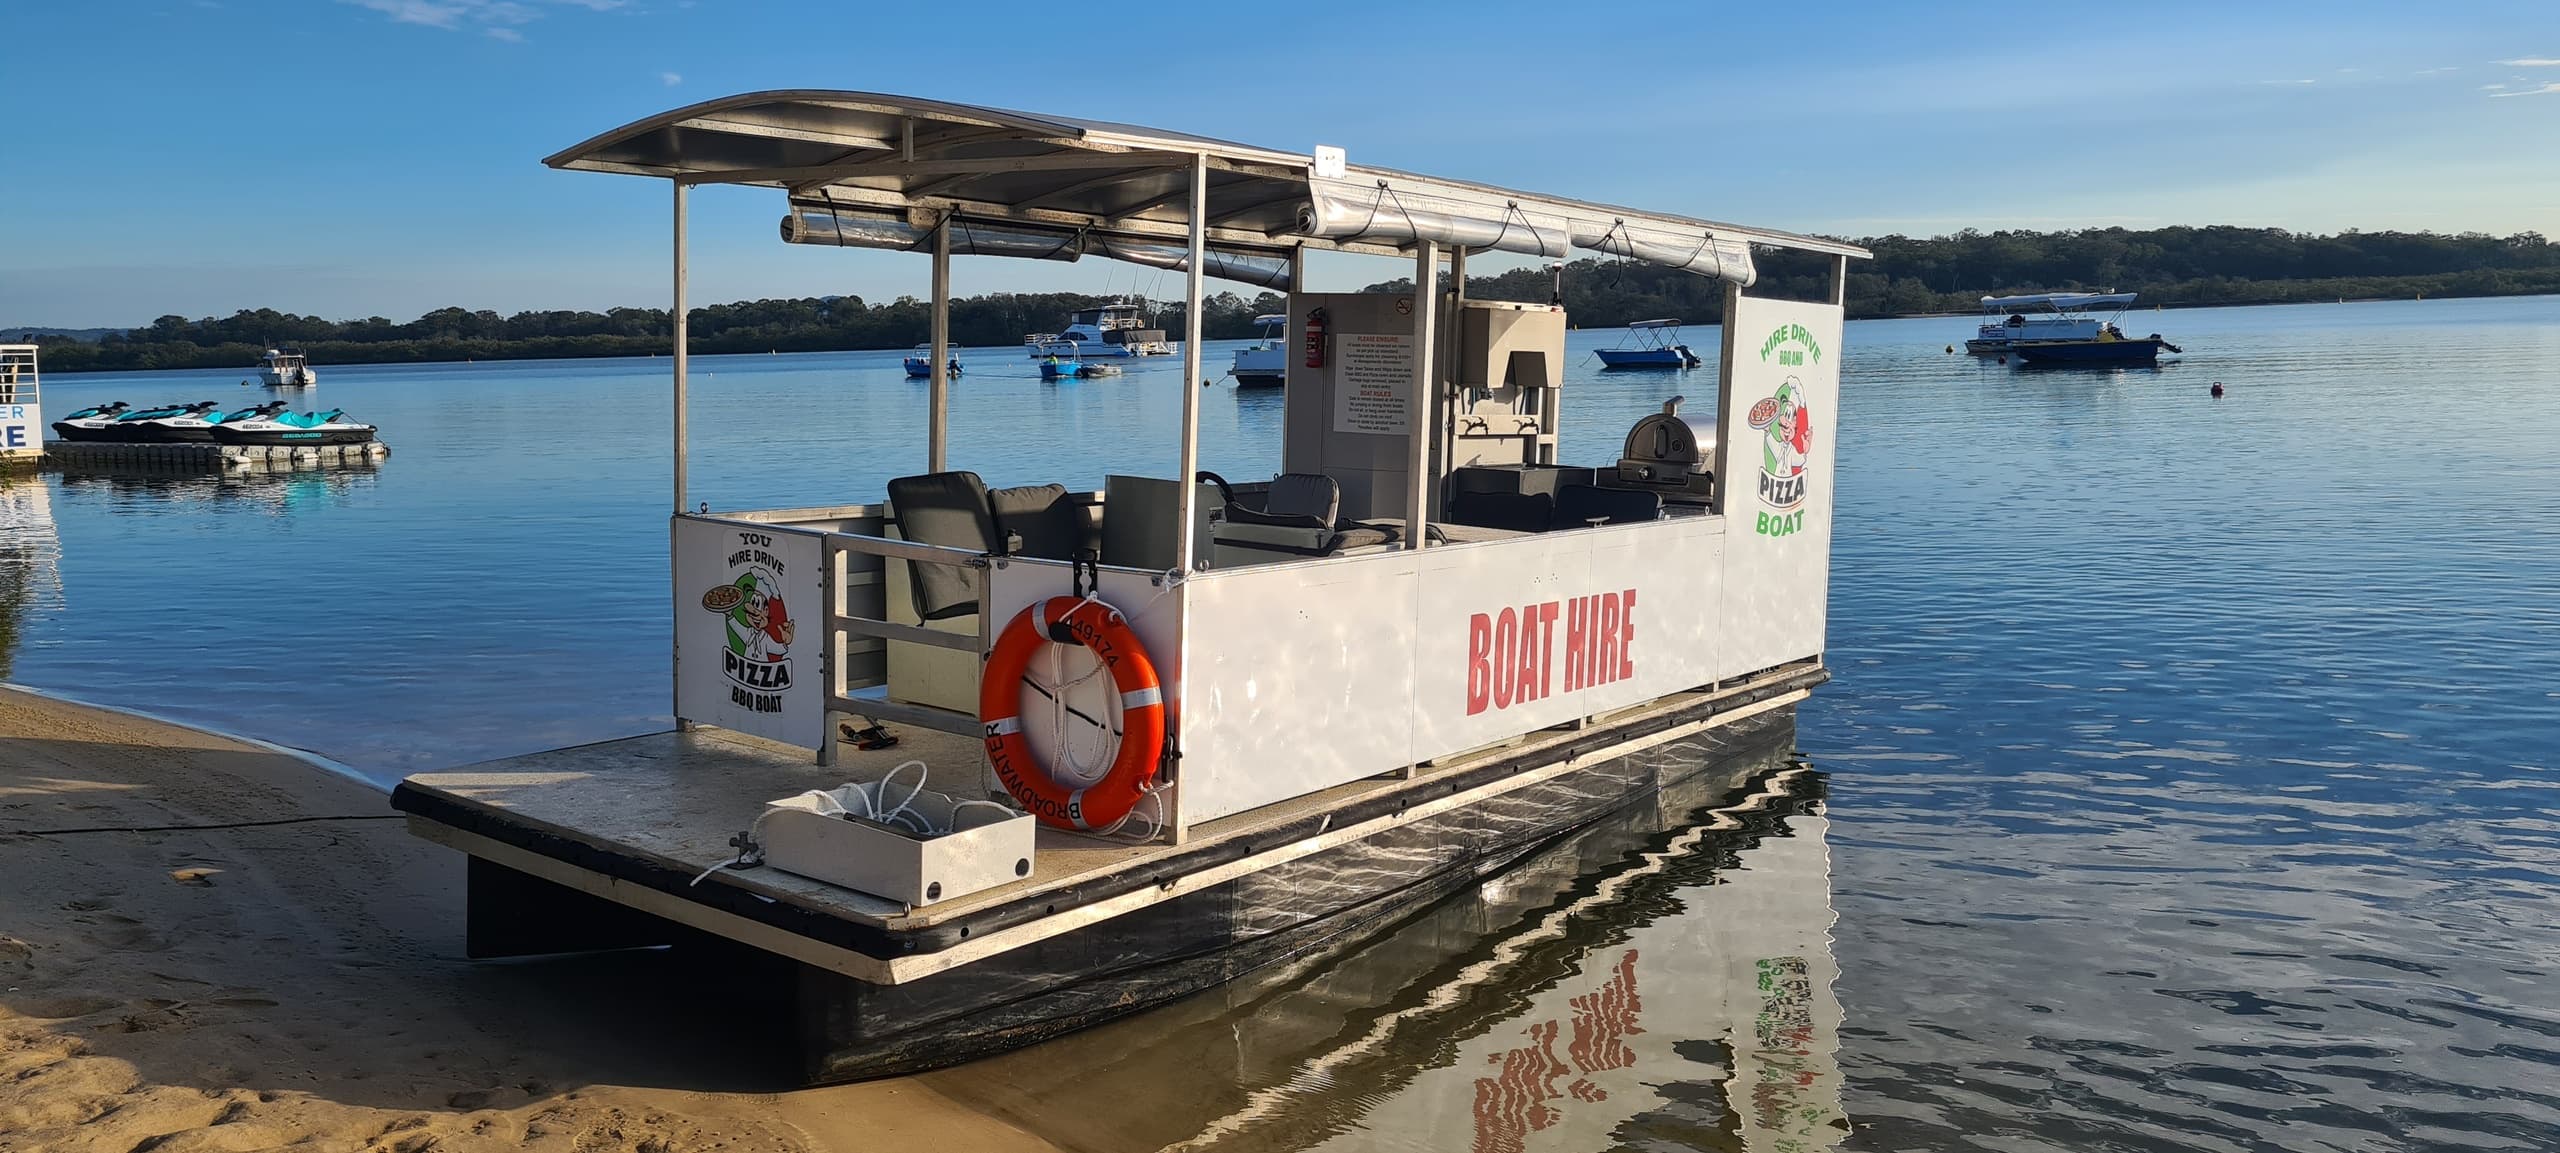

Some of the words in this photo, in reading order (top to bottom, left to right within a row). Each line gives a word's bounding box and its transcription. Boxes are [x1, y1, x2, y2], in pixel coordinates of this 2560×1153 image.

[1760, 324, 1788, 362] HIRE
[1791, 323, 1822, 365] DRIVE
[1779, 350, 1791, 367] BBQ
[1791, 350, 1804, 366] AND
[0, 425, 26, 447] E
[1759, 471, 1805, 504] PIZZA
[1756, 509, 1805, 537] BOAT
[739, 532, 772, 548] YOU
[728, 549, 752, 569] HIRE
[754, 550, 785, 577] DRIVE
[1466, 600, 1560, 717] BOAT
[1564, 588, 1637, 693] HIRE
[725, 652, 790, 688] PIZZA
[731, 686, 754, 712] BBQ
[755, 693, 782, 713] BOAT
[985, 722, 1081, 820] BROADWATER
